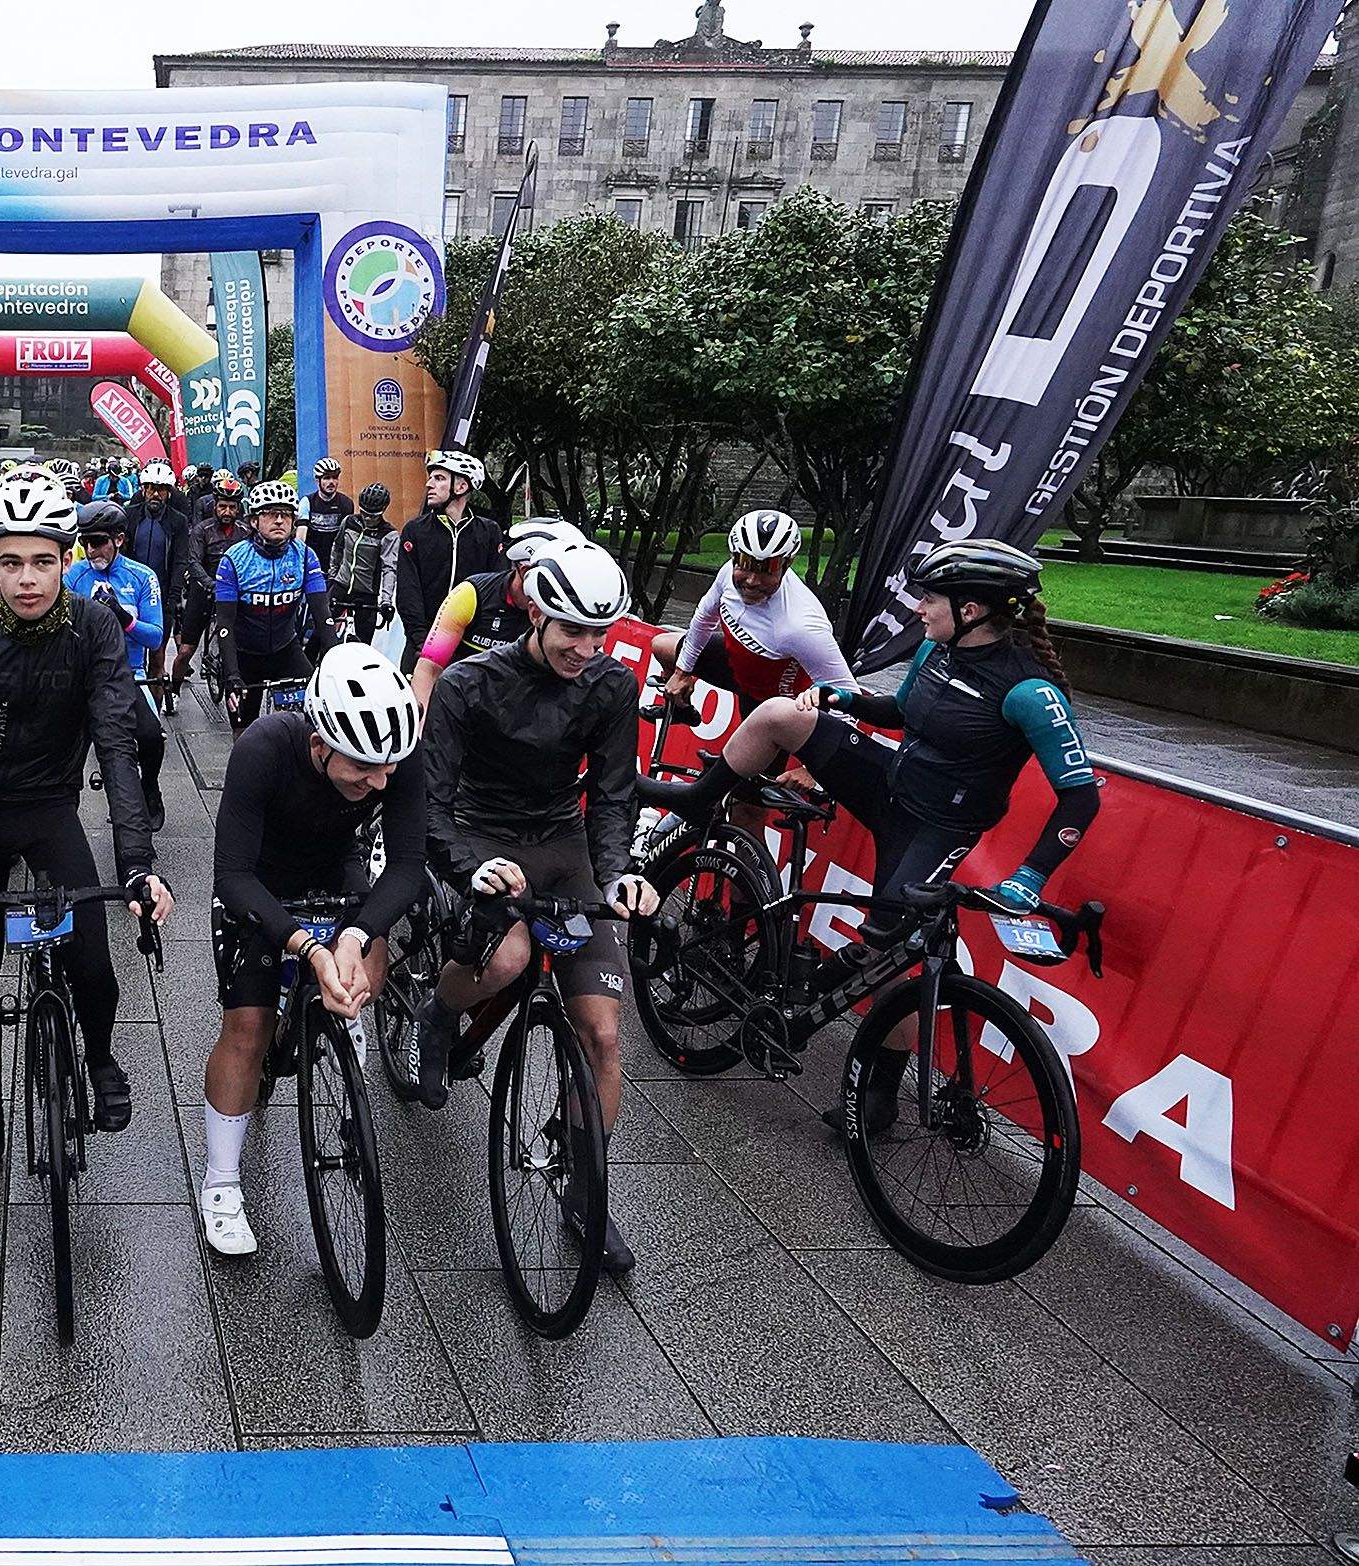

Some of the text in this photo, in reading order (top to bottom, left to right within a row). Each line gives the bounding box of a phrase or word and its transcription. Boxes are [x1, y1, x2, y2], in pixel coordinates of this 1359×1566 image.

[344, 239, 424, 269] DEPORTE
[340, 289, 431, 337] PONTEVEDRA
[1024, 136, 1252, 516] GESTIÓN DEPORTIVA
[20, 341, 88, 360] FROIZ
[359, 433, 420, 441] PONTEVEDRA
[471, 634, 491, 647] CLUB
[282, 692, 300, 701] 151
[695, 855, 739, 878] DT SWISS
[1011, 929, 1041, 945] 167
[845, 1057, 863, 1140] DT SWISS
